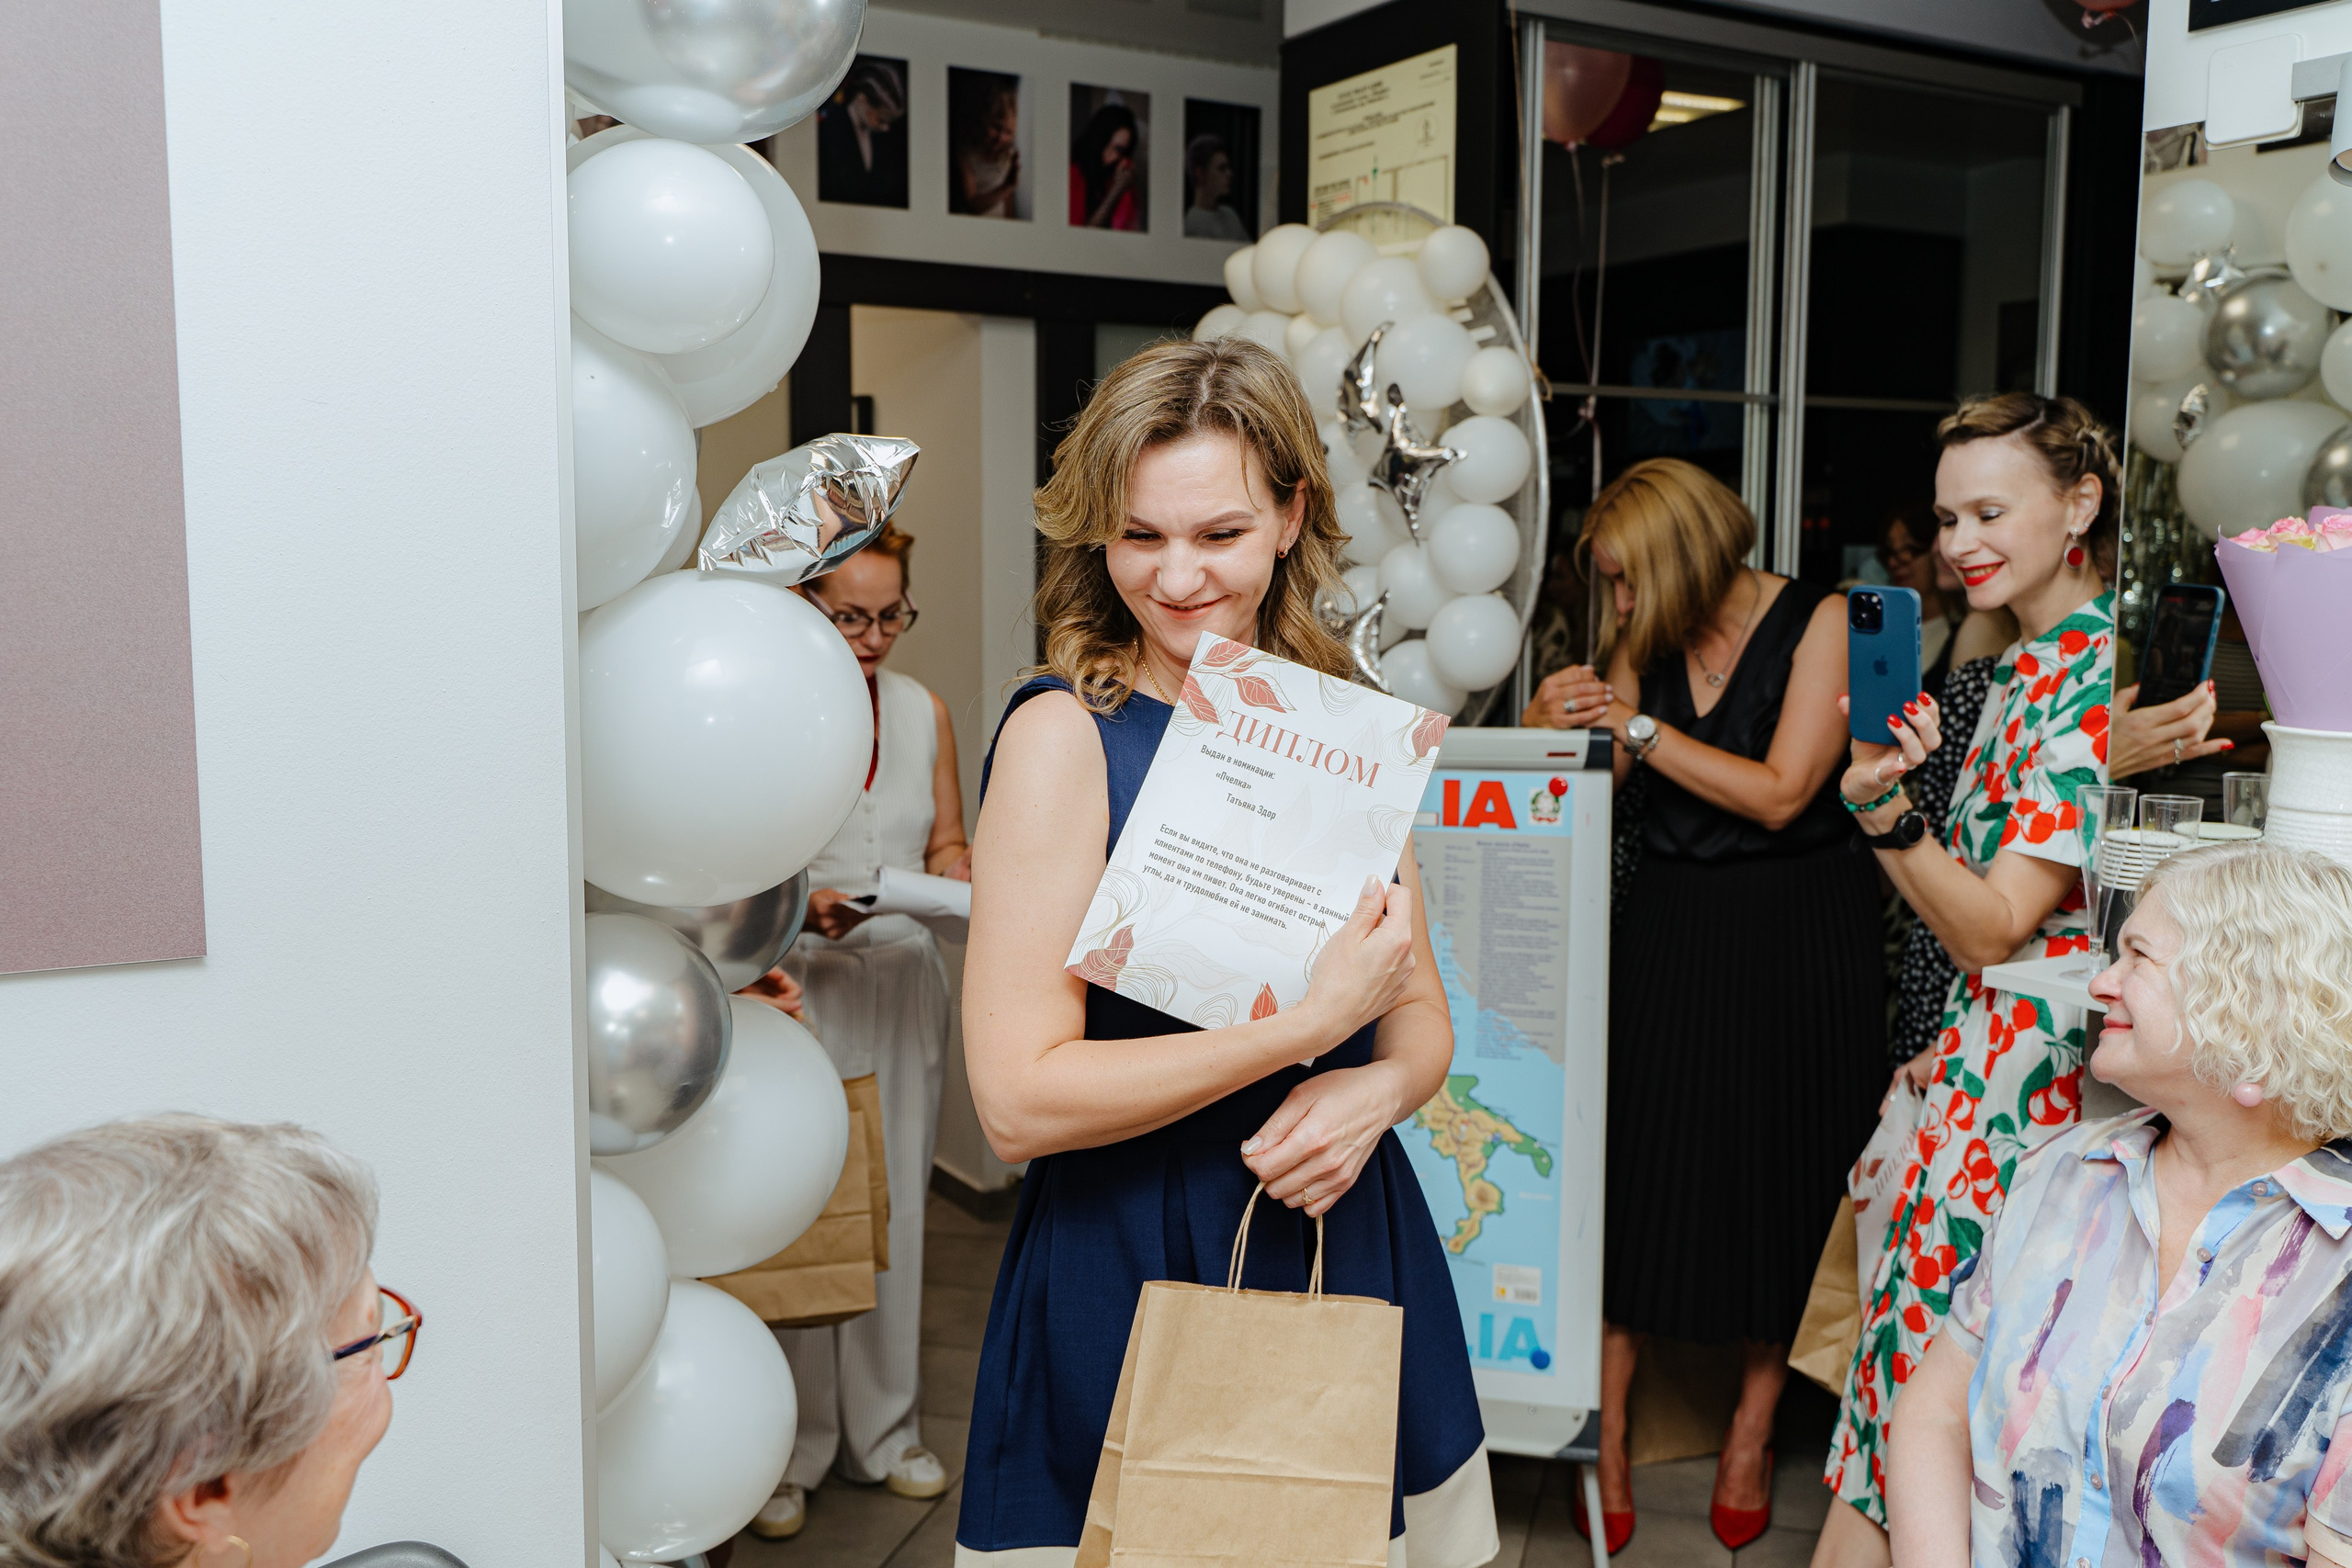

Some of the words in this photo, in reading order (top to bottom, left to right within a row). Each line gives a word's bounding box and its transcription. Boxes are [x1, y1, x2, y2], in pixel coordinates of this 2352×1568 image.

[1200, 744, 1227, 761] Выдан
[1232, 758, 1276, 780] номинации:
[1216, 710, 1382, 788] ДИПЛОМ
[1216, 771, 1252, 790] «Пчелка»
[1226, 792, 1257, 812] Татьяна
[1257, 805, 1277, 821] Здор
[1148, 851, 1176, 867] момент
[1176, 863, 1192, 874] она
[1191, 869, 1203, 878] им
[1203, 874, 1227, 889] пишет.
[1228, 882, 1244, 896] Она
[1244, 890, 1267, 905] легко
[1267, 900, 1298, 918] огибает
[1298, 912, 1327, 930] острые
[1154, 838, 1194, 860] клиентами
[1194, 854, 1205, 864] по
[1205, 859, 1243, 881] телефону,
[1245, 874, 1272, 891] будьте
[1271, 886, 1306, 905] уверены
[1317, 906, 1350, 921] данный
[1159, 823, 1179, 838] Если
[1178, 833, 1191, 843] вы
[1191, 838, 1218, 856] видите,
[1221, 850, 1234, 861] что
[1234, 855, 1250, 866] она
[1250, 862, 1260, 871] не
[1259, 866, 1317, 894] разговаривает
[1316, 888, 1322, 897] с
[1141, 864, 1163, 879] углы,
[1163, 874, 1176, 883] да
[1182, 880, 1229, 905] трудолюбия
[1229, 899, 1240, 909] ей
[1239, 904, 1250, 914] не
[1250, 908, 1287, 930] занимать.
[1467, 1314, 1541, 1361] IA
